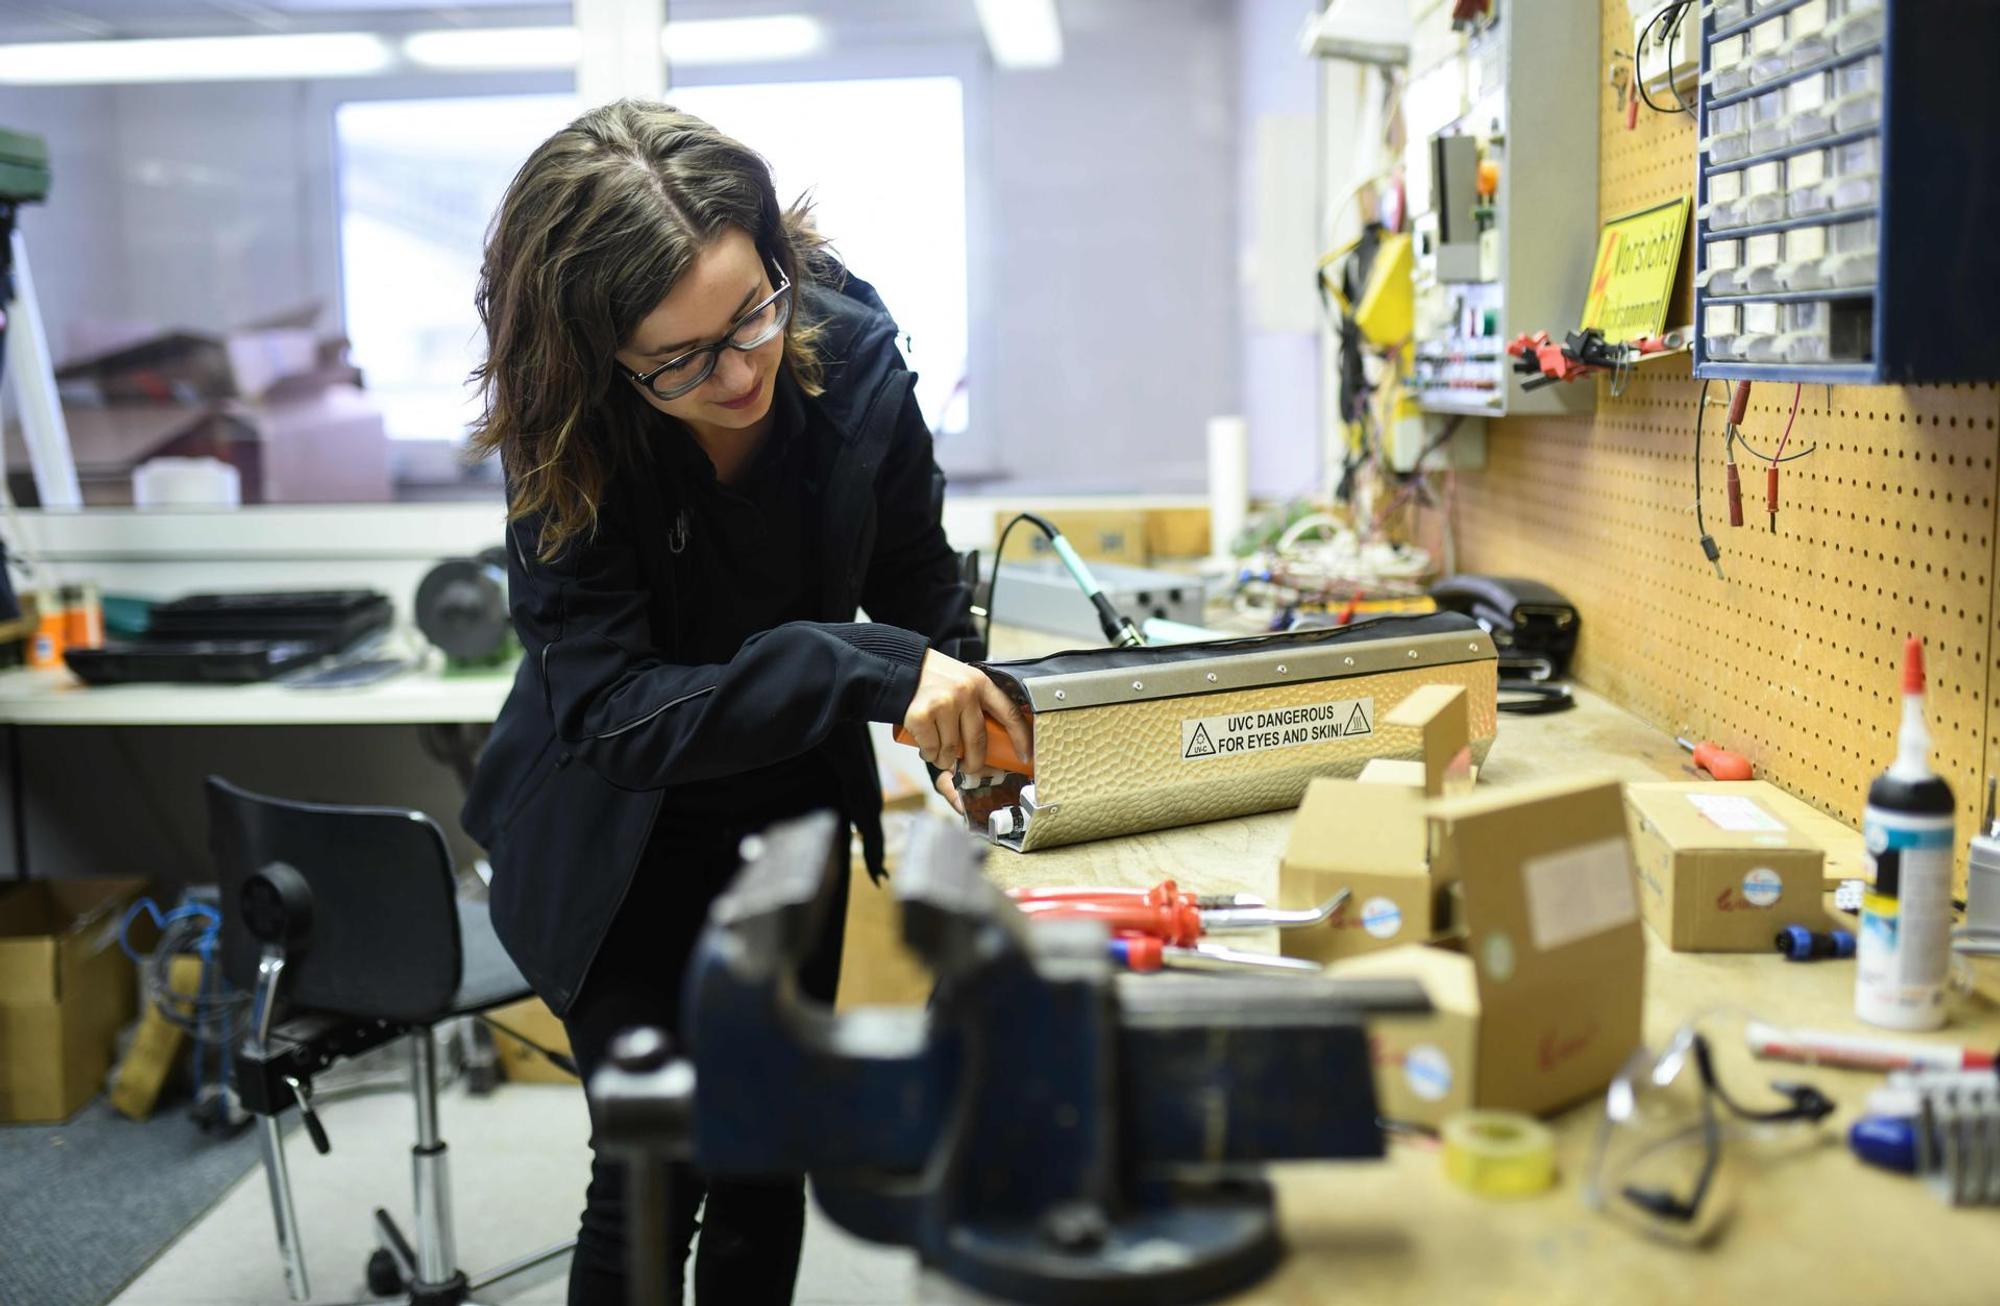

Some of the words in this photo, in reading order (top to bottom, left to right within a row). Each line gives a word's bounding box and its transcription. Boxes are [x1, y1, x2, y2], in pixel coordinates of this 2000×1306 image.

[1615, 220, 1676, 275] Vorsicht
[1228, 716, 1254, 732] UVC
[1257, 705, 1334, 728] DANGEROUS
[1218, 736, 1244, 753] FOR
[1248, 732, 1280, 749] EYES
[1282, 728, 1308, 745] AND
[1311, 723, 1343, 740] SKIN!
